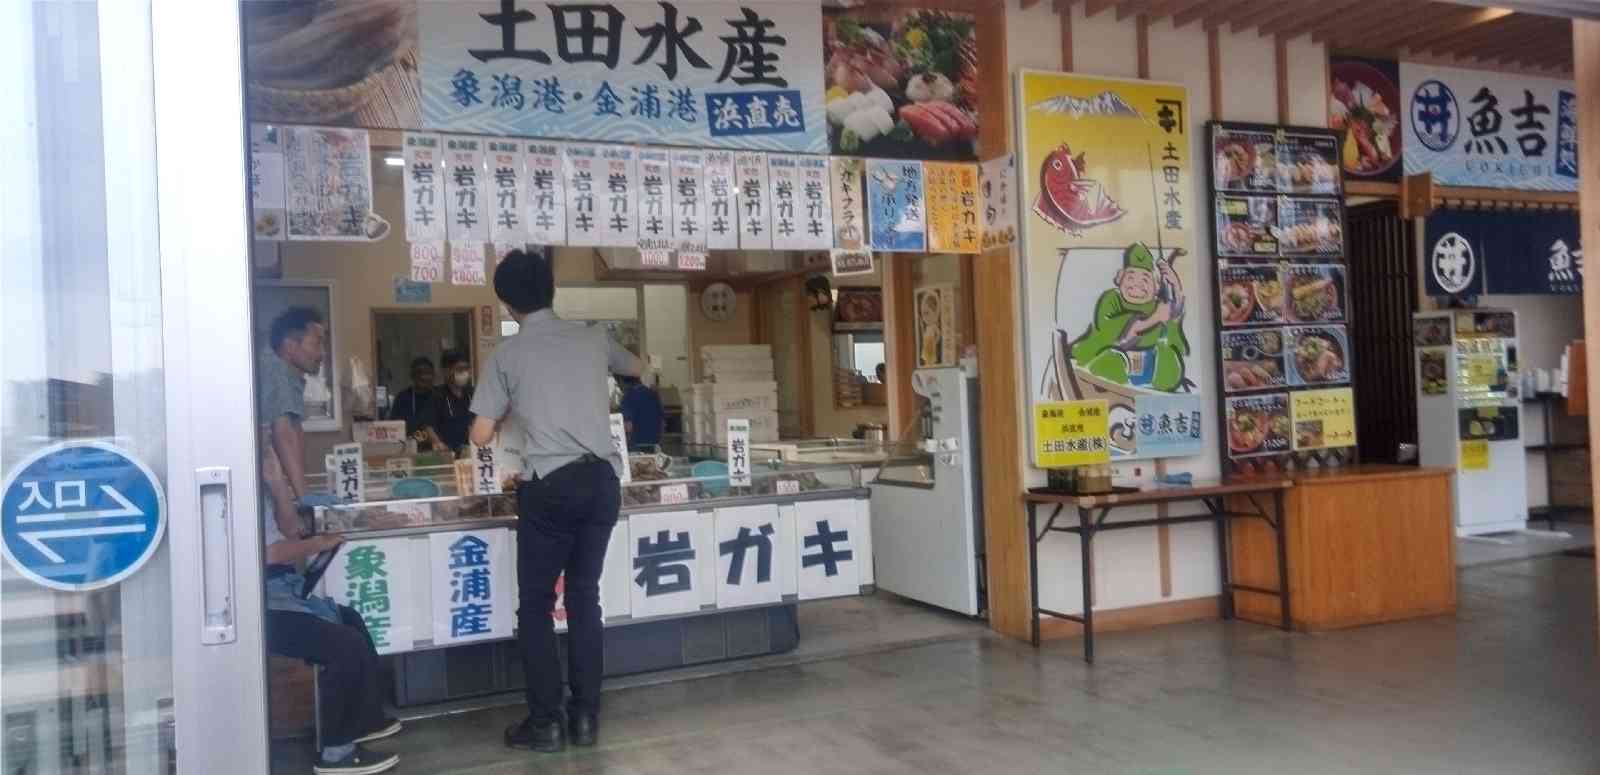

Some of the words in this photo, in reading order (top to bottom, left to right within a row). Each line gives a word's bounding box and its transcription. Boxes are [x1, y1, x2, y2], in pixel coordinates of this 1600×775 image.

[467, 0, 788, 88] 土田水産
[450, 68, 698, 122] 象潟港・金浦港
[713, 96, 801, 131] 浜直売
[1464, 86, 1551, 158] 魚吉
[412, 162, 434, 226] 岩ガキ
[453, 165, 477, 228] 岩ガキ
[494, 167, 519, 229] 岩ガキ
[533, 169, 555, 230] 岩ガキ
[572, 171, 594, 232] 岩ガキ
[607, 173, 629, 232] 岩ガキ
[643, 175, 664, 235] 岩ガキ
[677, 177, 699, 236] 岩ガキ
[711, 177, 730, 235] 岩ガキ
[743, 178, 763, 236] 岩ガキ
[776, 180, 795, 236] 岩ガキ
[804, 181, 824, 236] 岩ガキ
[1161, 142, 1183, 230] 土田水産
[1157, 411, 1189, 435] 魚吉
[476, 446, 495, 493] 岩ガキ
[731, 437, 746, 482] 岩ガキ
[18, 480, 87, 511] 入口
[447, 534, 493, 638] 金浦産
[632, 519, 853, 598] 岩ガキ
